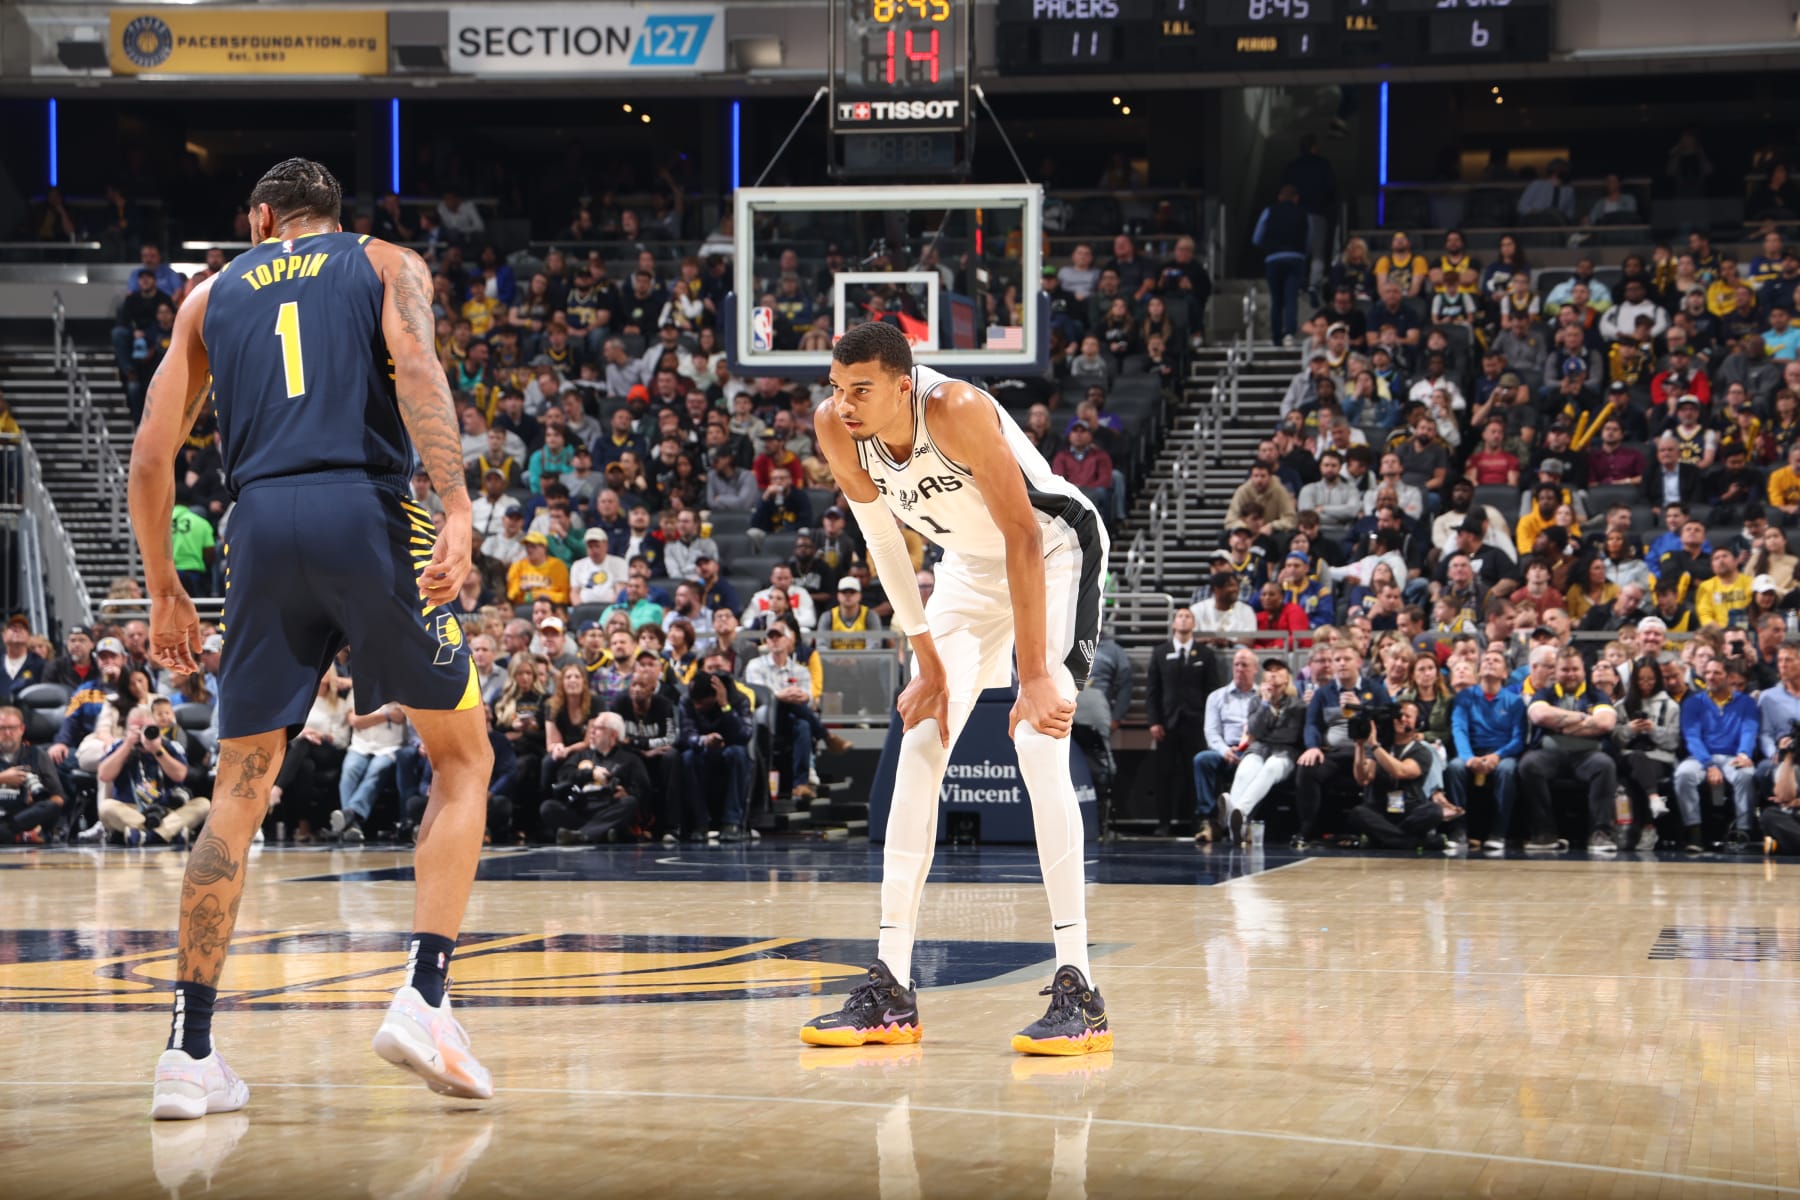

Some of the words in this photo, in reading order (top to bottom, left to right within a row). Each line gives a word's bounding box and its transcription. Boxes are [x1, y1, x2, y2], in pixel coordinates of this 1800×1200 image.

[874, 0, 950, 22] 8:45
[1033, 0, 1119, 19] PACERS
[177, 36, 377, 50] PACERSFOUNDATION.org
[458, 26, 631, 57] SECTION
[642, 24, 699, 57] 127
[1072, 31, 1099, 56] 11
[1236, 37, 1278, 51] PERIOD
[886, 29, 940, 84] 14
[871, 101, 959, 120] TISSOT
[241, 253, 328, 291] TOPPIN
[275, 301, 305, 398] 1
[920, 516, 952, 534] 1
[940, 783, 1022, 803] Vincent
